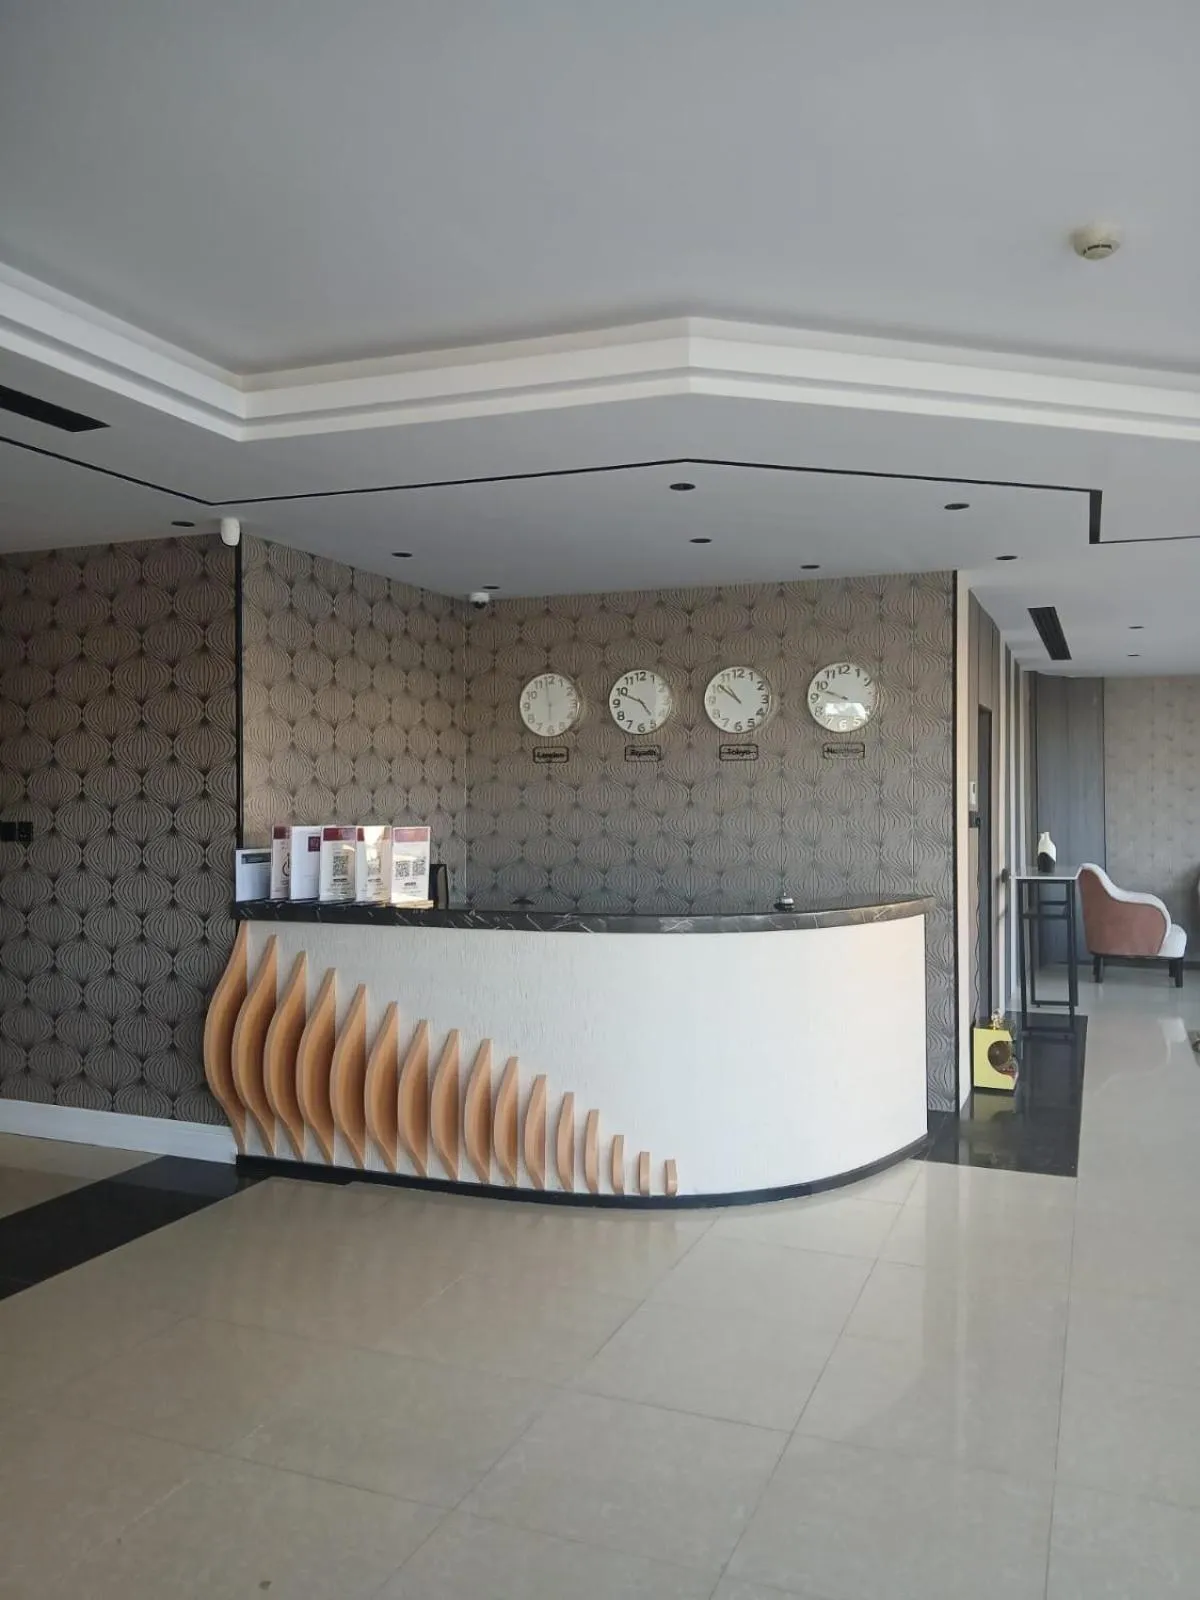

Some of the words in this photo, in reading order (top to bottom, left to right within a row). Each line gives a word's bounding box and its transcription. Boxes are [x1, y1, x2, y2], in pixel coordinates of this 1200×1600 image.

[732, 669, 745, 678] 12
[837, 665, 850, 674] 12
[855, 668, 861, 677] 1
[635, 672, 646, 681] 12
[650, 675, 655, 683] 1
[749, 672, 754, 680] 1
[825, 670, 835, 679] 11
[535, 680, 543, 688] 11
[544, 676, 555, 685] 12
[559, 679, 563, 687] 1
[625, 677, 633, 685] 11
[757, 681, 765, 690] 2
[815, 681, 828, 690] 10
[526, 691, 537, 700] 10
[616, 687, 628, 696] 10
[761, 695, 768, 703] 3
[810, 693, 819, 702] 9
[523, 702, 530, 711] 9
[612, 699, 620, 708] 9
[617, 711, 625, 720] 8
[756, 708, 765, 716] 4
[626, 720, 633, 729] 7
[722, 718, 729, 727] 7
[735, 721, 742, 731] 6
[747, 719, 755, 728] 5
[637, 723, 645, 732] 6
